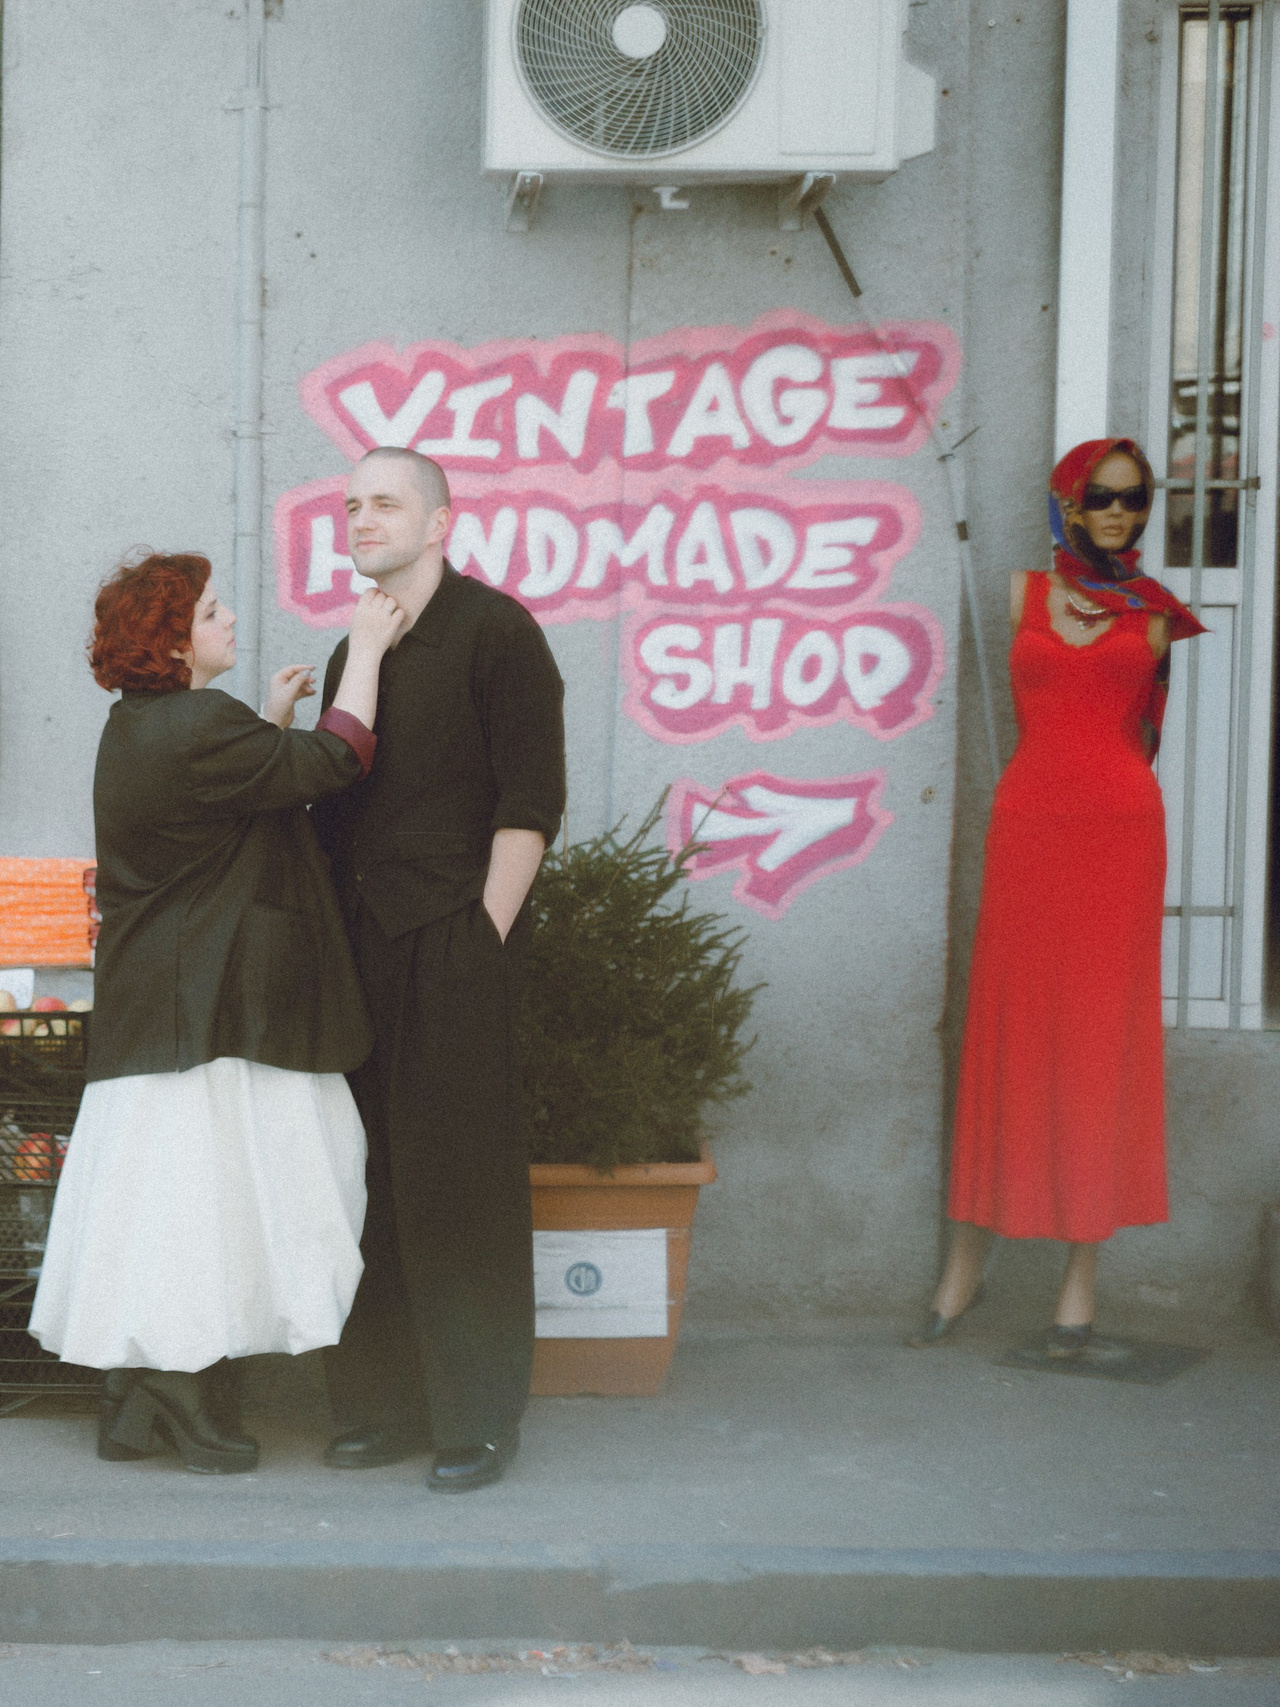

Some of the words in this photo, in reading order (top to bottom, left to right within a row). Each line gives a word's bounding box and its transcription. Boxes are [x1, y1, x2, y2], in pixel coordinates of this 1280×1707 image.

[338, 343, 918, 460] VINTAGE
[305, 501, 880, 597] HNDMADE
[639, 617, 912, 711] SHOP
